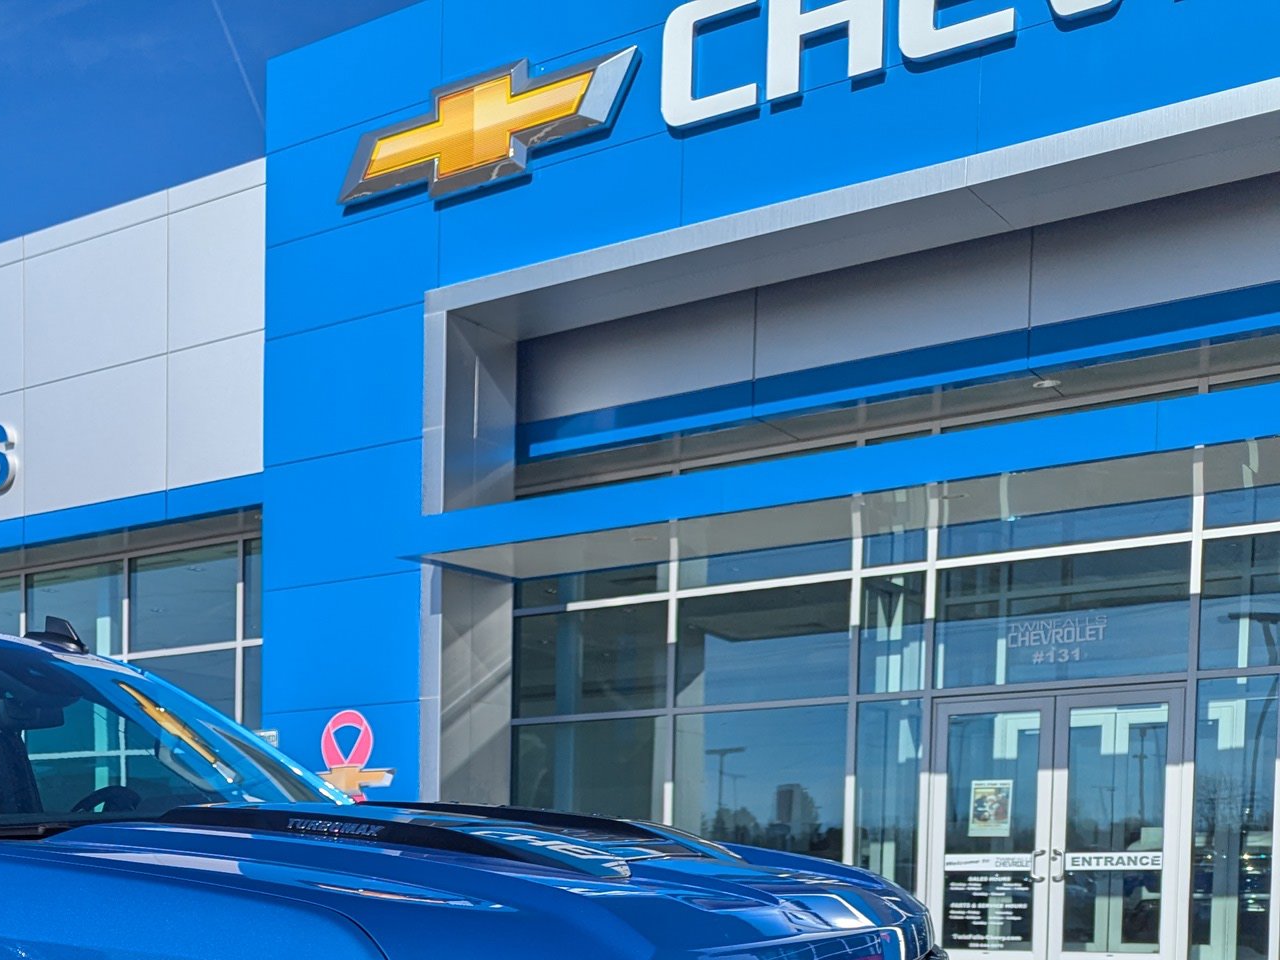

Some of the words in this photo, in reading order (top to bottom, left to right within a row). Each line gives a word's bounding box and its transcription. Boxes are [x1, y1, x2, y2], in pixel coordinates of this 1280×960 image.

[1008, 625, 1106, 648] CHEVROLET
[1032, 648, 1081, 665] #131
[287, 818, 384, 837] TURBOMAX
[1070, 856, 1161, 867] ENTRANCE
